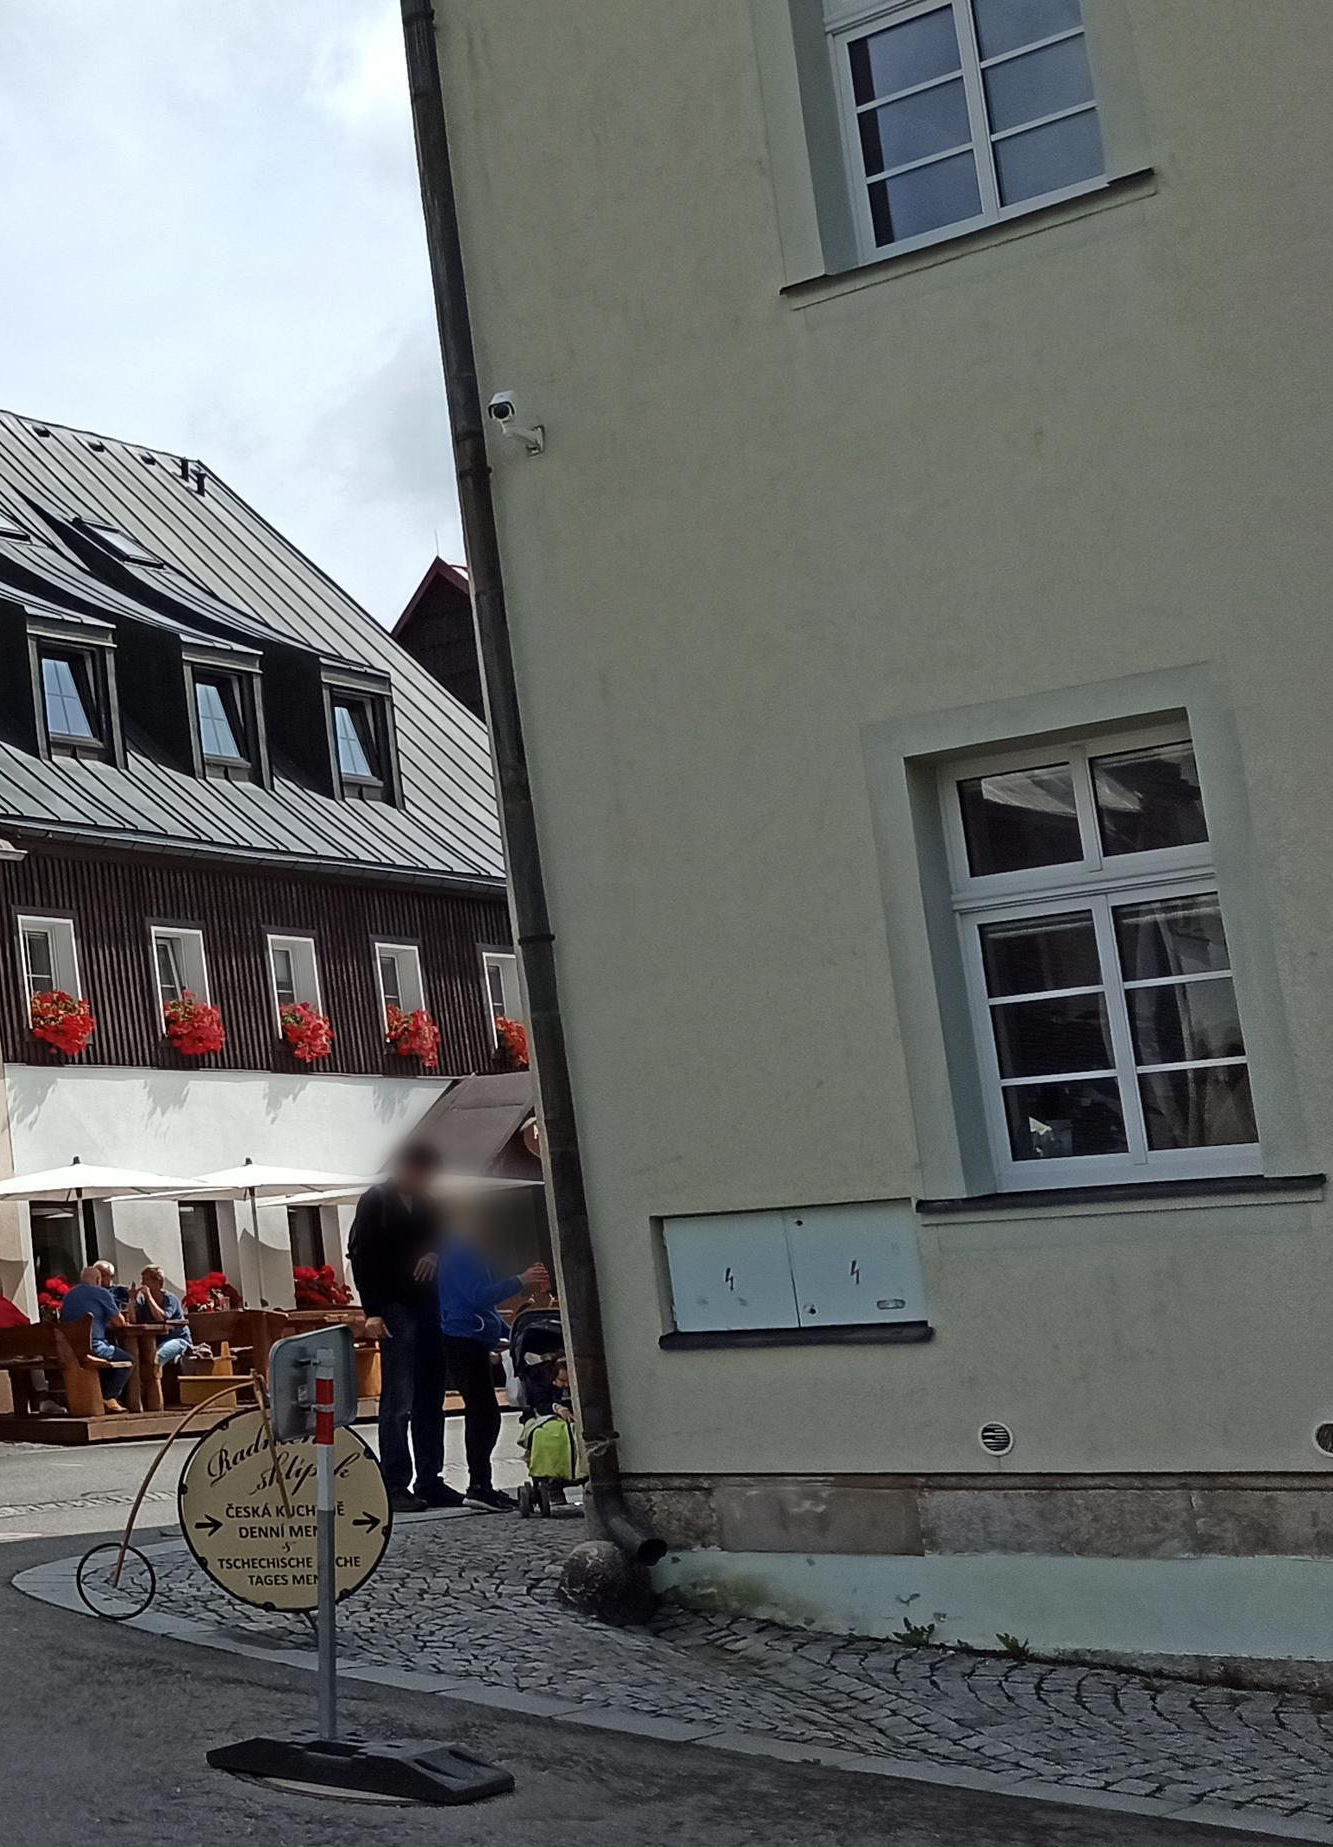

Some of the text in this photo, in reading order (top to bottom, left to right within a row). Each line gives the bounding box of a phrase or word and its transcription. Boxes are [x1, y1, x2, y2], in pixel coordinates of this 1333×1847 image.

[249, 1450, 361, 1496] sklípk
[225, 1501, 346, 1519] ČESKÁ KUCHĚ
[238, 1523, 318, 1539] DENNÍ MEN
[217, 1556, 313, 1569] TSCHECHISCHE
[247, 1574, 318, 1586] TAGES MEN
